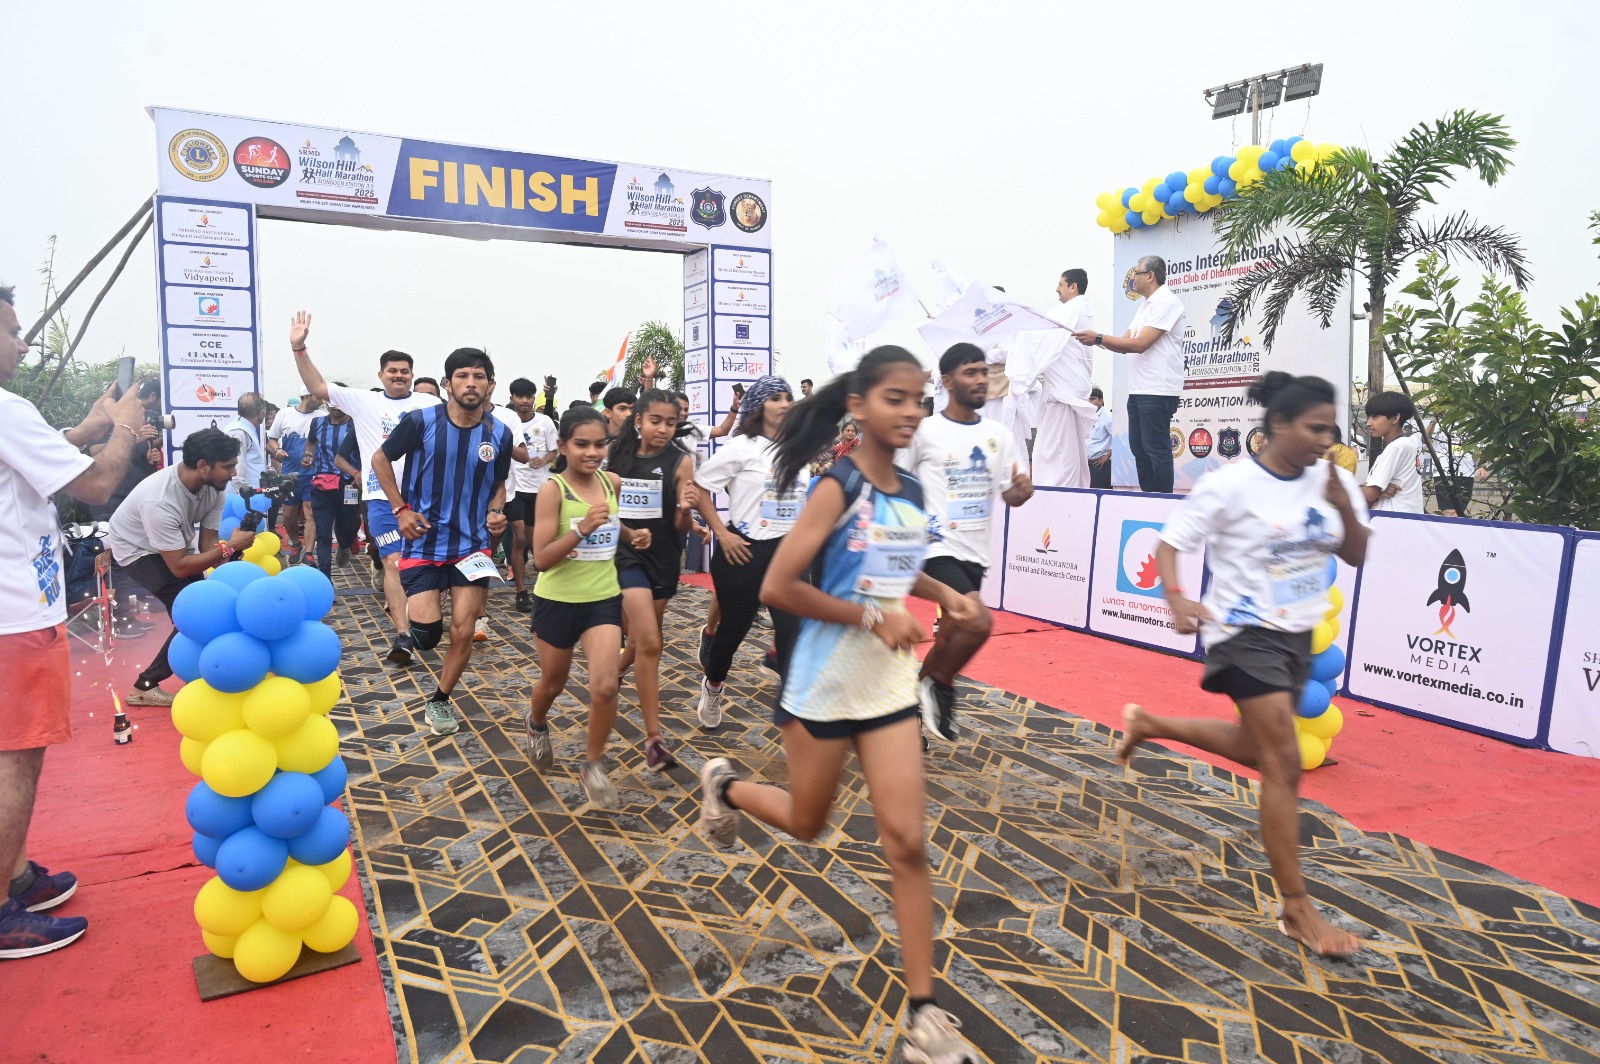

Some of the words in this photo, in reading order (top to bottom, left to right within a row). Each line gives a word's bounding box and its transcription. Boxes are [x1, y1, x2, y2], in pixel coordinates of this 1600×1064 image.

[188, 140, 209, 149] LIONS
[299, 156, 334, 170] Wilson
[336, 160, 356, 172] Hill
[241, 166, 284, 176] SUNDAY
[315, 169, 333, 178] Half
[335, 171, 374, 182] Marathon
[409, 157, 598, 216] FINISH
[354, 189, 374, 198] 2025
[628, 192, 654, 202] Wilson
[656, 194, 671, 204] Hill
[654, 204, 684, 212] Marathon
[1166, 260, 1192, 276] ions
[1184, 272, 1199, 284] Club
[1201, 270, 1208, 281] of
[1210, 264, 1251, 280] Dharampur
[184, 273, 234, 282] Vidyapeeth
[1184, 330, 1196, 338] MD
[200, 340, 222, 348] CCE
[1190, 354, 1207, 366] Half
[1210, 352, 1252, 364] Marathon
[1192, 367, 1218, 376] MONSOON
[1220, 366, 1241, 374] EDITION
[1178, 398, 1192, 408] EYE
[1194, 396, 1244, 408] DONATION
[621, 494, 648, 504] 1203
[376, 530, 400, 548] INDIA
[1016, 555, 1040, 564] SHRIMAD
[1041, 559, 1078, 570] RAJCHANDRA
[1009, 563, 1029, 572] Hospital
[1041, 568, 1064, 578] Research
[1066, 573, 1086, 582] Centre
[1102, 597, 1126, 606] LUNAR
[1128, 602, 1175, 616] AUTOMATIO
[1407, 634, 1482, 664] VORTEX
[1410, 654, 1470, 676] MEDIA
[1364, 662, 1524, 708] www.vortexmedia.co.in
